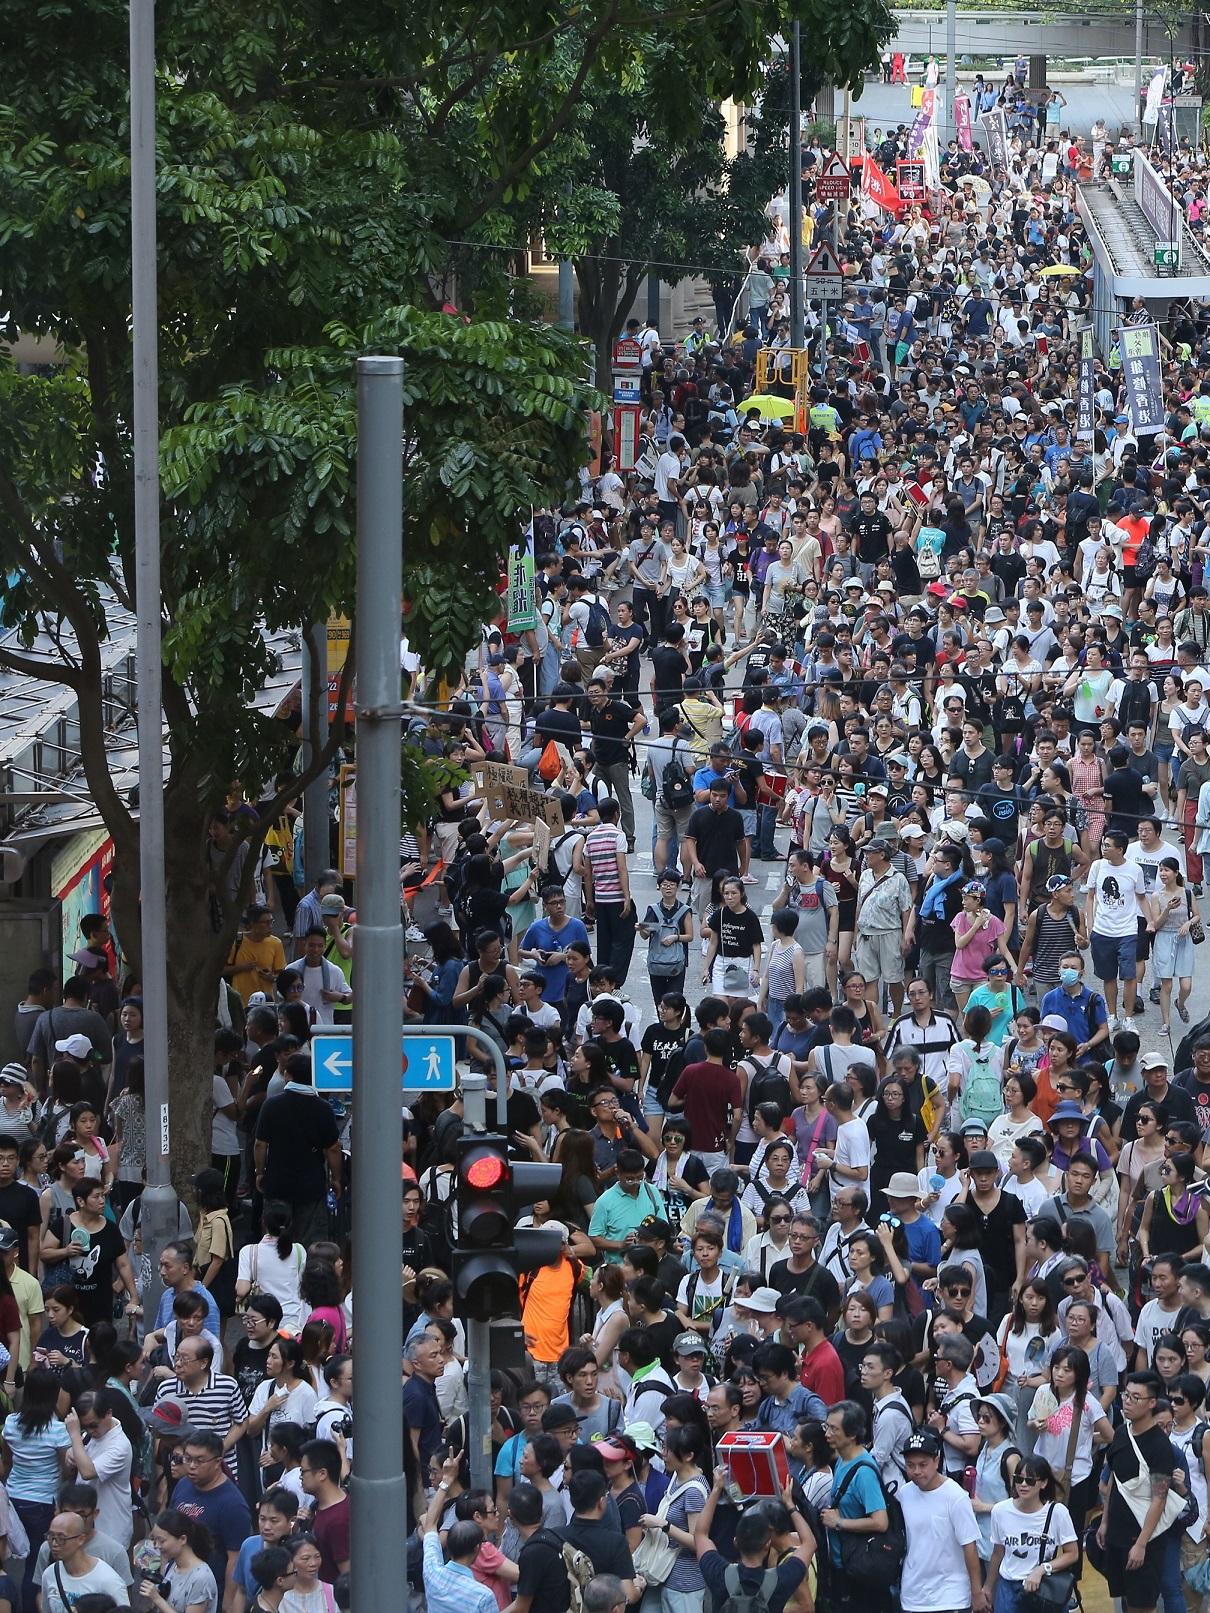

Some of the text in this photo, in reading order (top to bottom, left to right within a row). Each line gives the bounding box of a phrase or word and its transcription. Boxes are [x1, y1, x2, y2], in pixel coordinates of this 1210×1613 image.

[811, 288, 839, 296] 五十米
[1004, 1535, 1019, 1546] AIR
